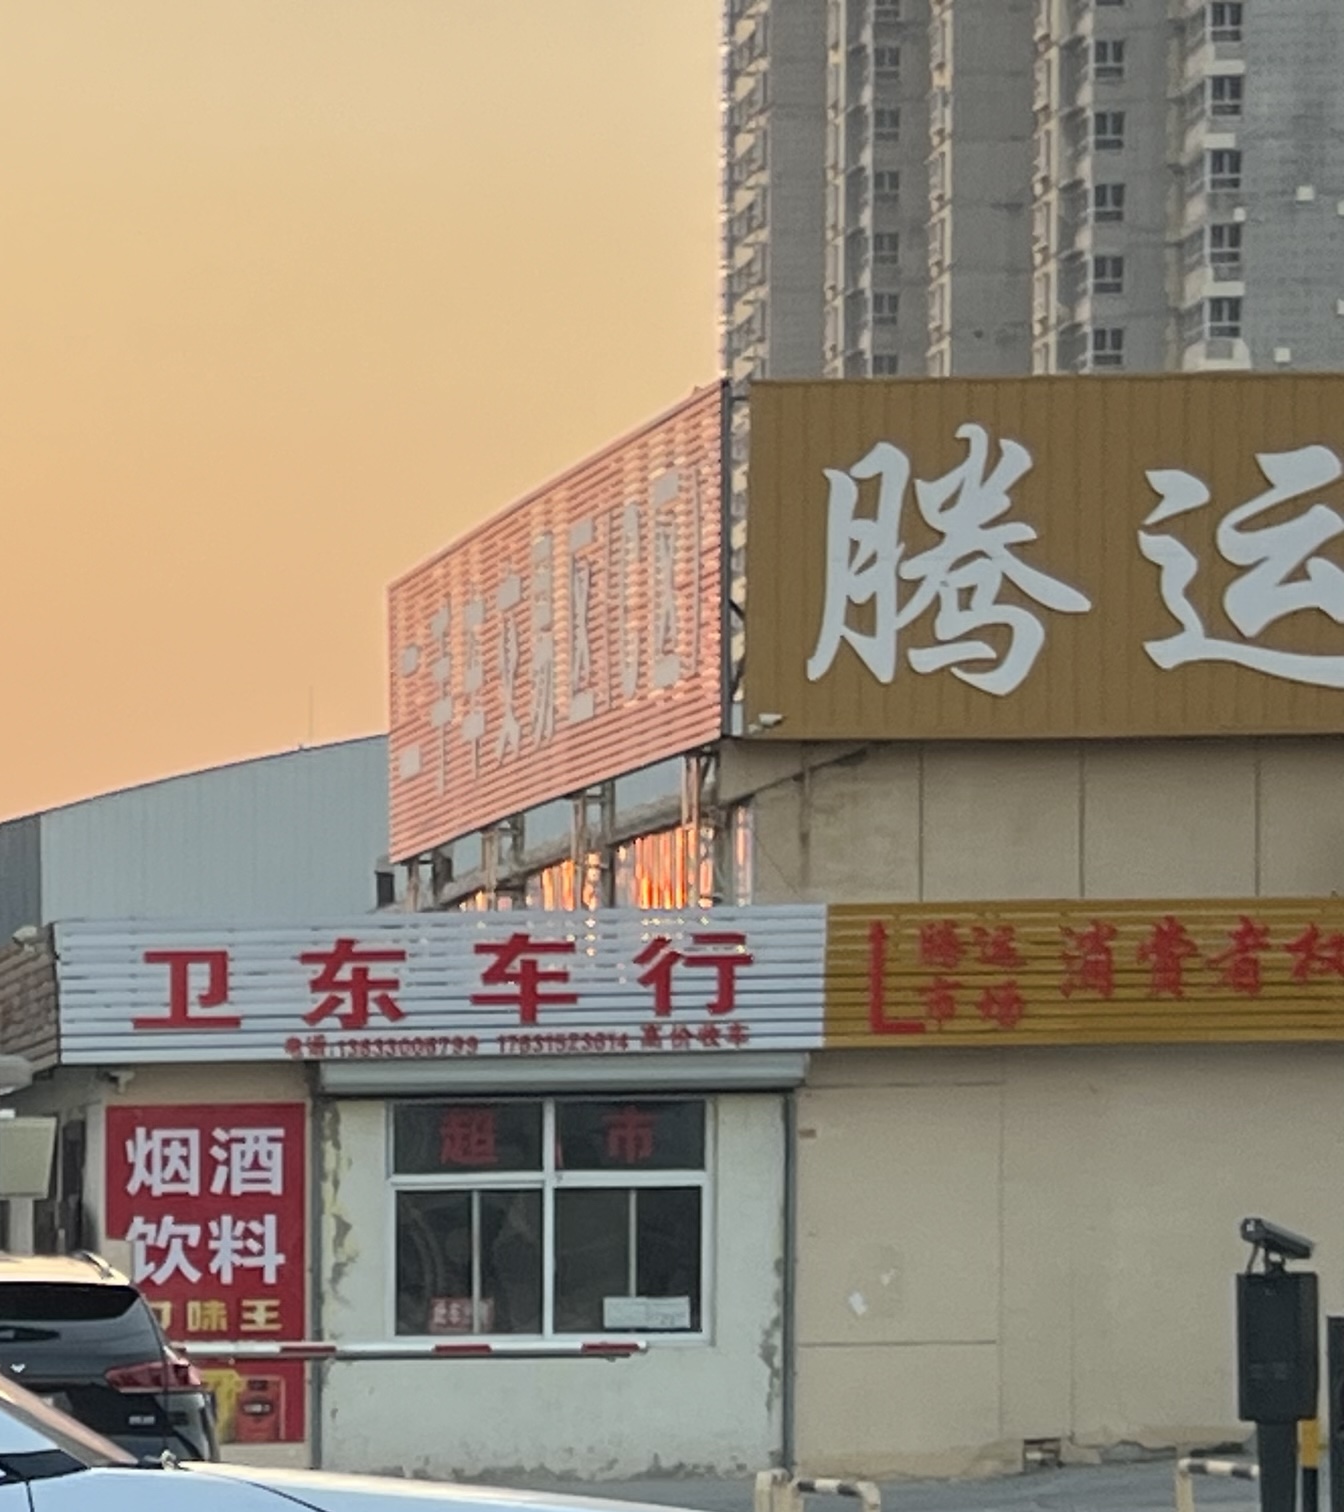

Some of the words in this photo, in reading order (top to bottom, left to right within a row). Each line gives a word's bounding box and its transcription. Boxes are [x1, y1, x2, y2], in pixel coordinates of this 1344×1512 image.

[806, 423, 1344, 695] 腾运
[132, 931, 754, 1030] 卫东车行
[125, 1126, 285, 1197] 烟酒
[125, 1213, 286, 1286] 饮料
